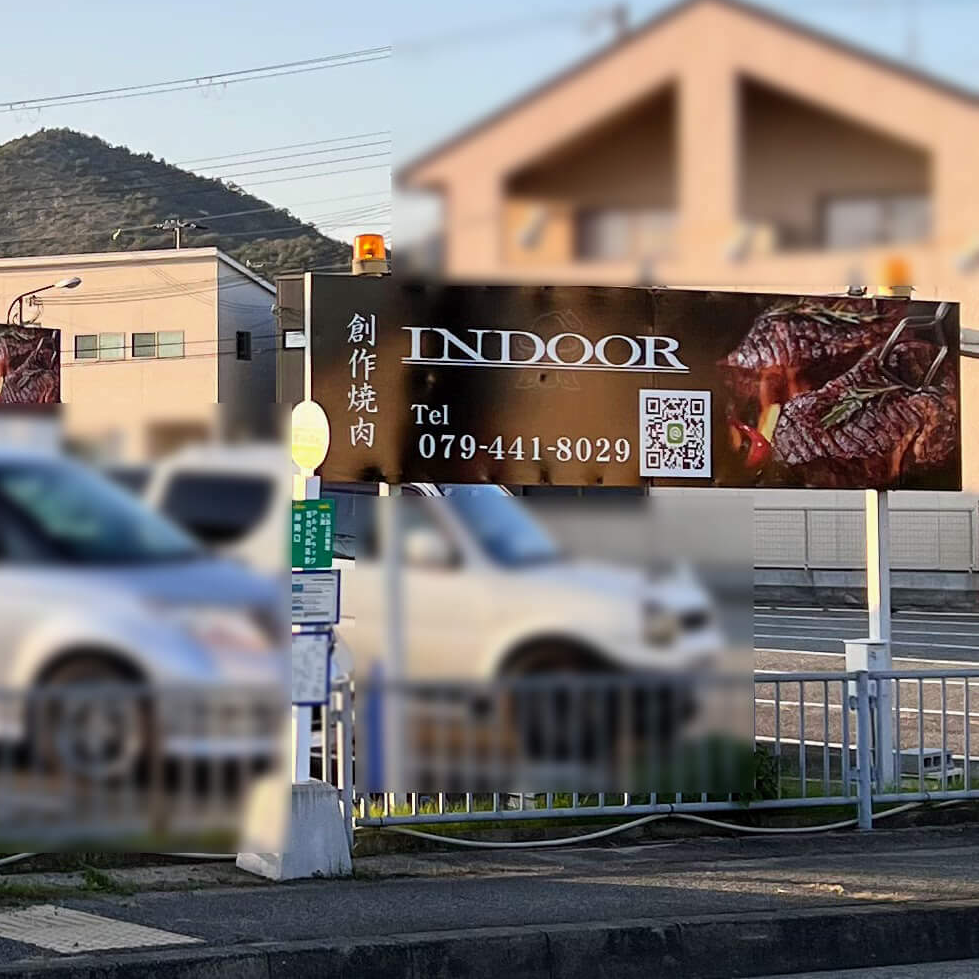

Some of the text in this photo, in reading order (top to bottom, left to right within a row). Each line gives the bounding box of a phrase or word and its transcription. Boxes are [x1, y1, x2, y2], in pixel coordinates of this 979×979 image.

[403, 325, 689, 372] INDOOR
[345, 310, 378, 449] 創作焼肉
[411, 403, 450, 428] Tel
[417, 433, 632, 464] 079-441-8029
